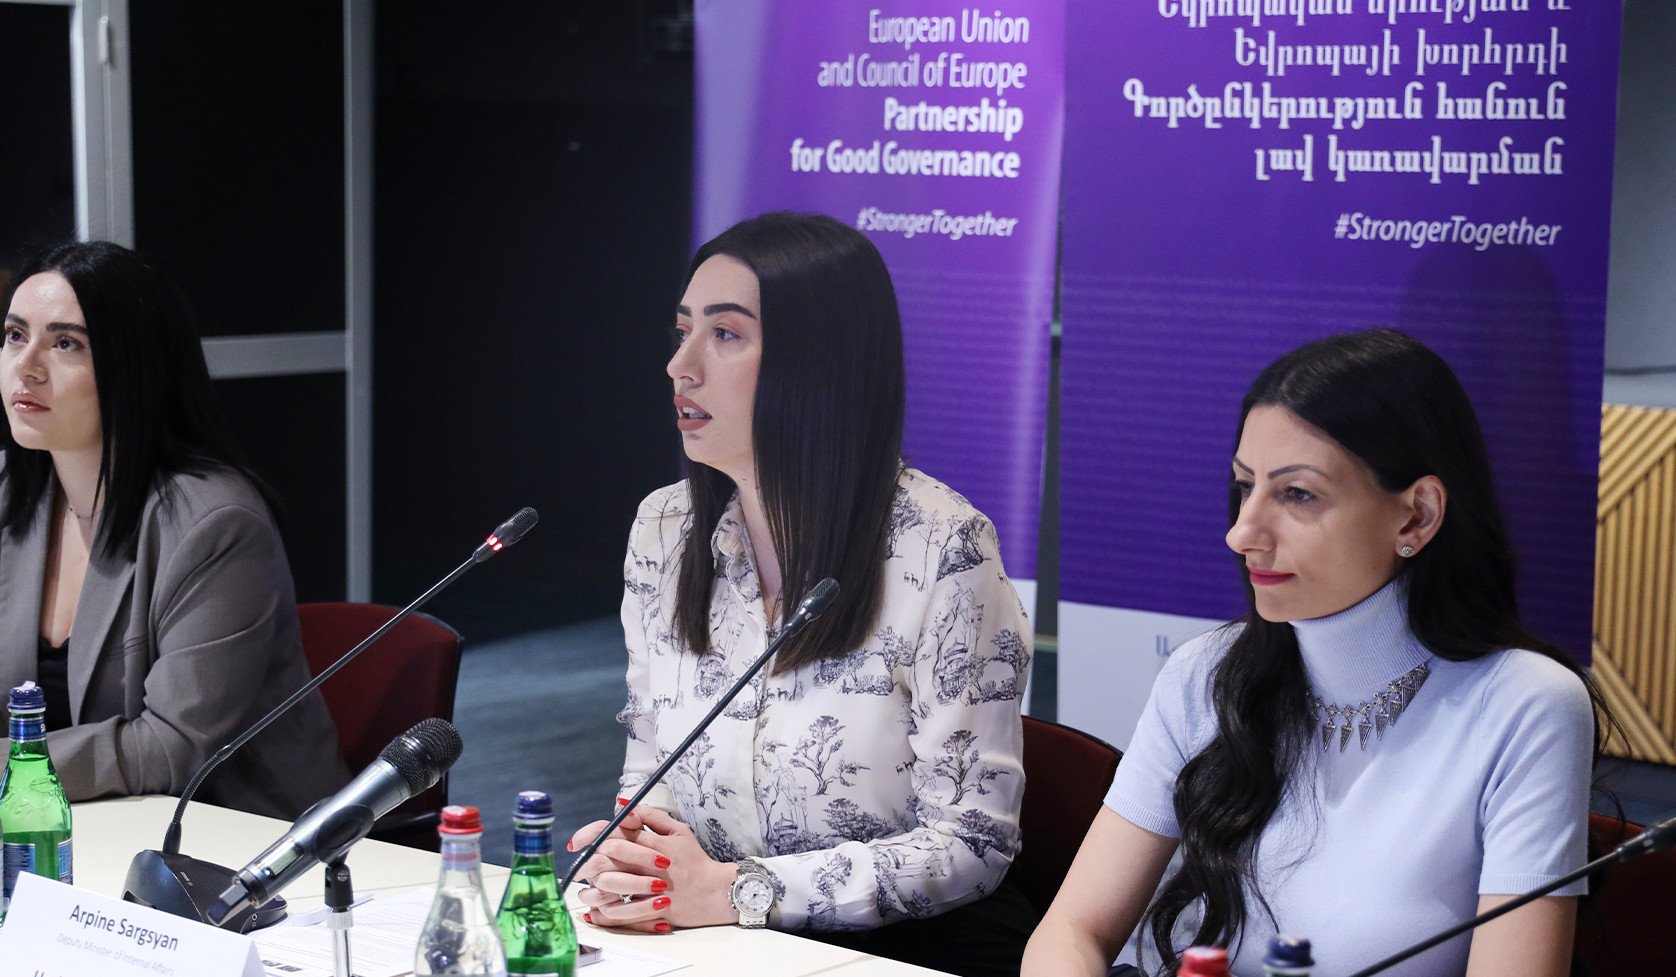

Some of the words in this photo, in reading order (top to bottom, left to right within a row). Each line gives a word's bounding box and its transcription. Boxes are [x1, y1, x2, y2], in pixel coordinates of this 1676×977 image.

[868, 9, 955, 50] European
[961, 8, 1030, 43] Union
[1234, 27, 1400, 76] Եվրոպայի
[1416, 27, 1568, 75] խորհրդի
[817, 53, 854, 87] and
[857, 53, 920, 87] Council
[923, 52, 947, 87] of
[949, 53, 1028, 96] Europe
[884, 97, 1023, 141] Partnership
[1123, 78, 1424, 129] Գործընկերություն
[1436, 81, 1567, 119] հանուն
[790, 138, 824, 172] for
[826, 140, 880, 173] Good
[882, 141, 1021, 178] Governance
[1255, 134, 1314, 181] լավ
[1328, 134, 1564, 184] կառավարման
[857, 207, 1019, 240] #StrongerTogether
[1334, 213, 1562, 251] #StrongerTogether
[57, 932, 83, 950] Deputy
[83, 940, 112, 958] Minister
[113, 950, 122, 960] of
[69, 904, 115, 931] Arpine
[118, 918, 179, 951] Sargsyan
